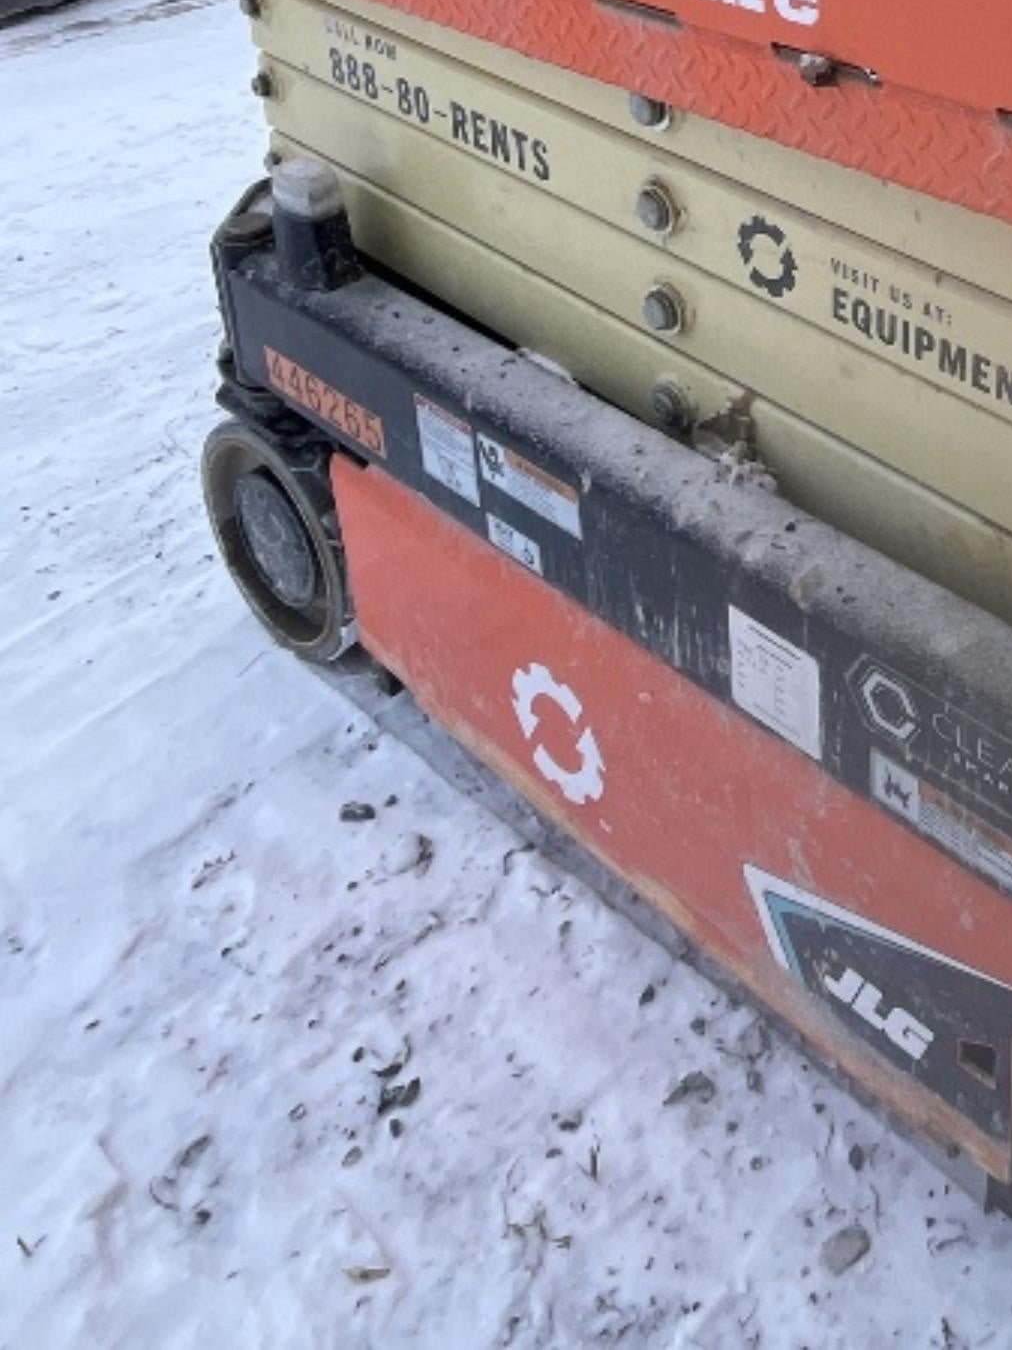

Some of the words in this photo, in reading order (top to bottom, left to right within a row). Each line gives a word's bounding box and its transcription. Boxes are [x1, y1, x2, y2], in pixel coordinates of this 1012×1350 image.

[329, 47, 550, 181] 888-80-RENTS
[830, 257, 880, 294] VISIT
[889, 284, 913, 310] US
[923, 301, 952, 327] AT:
[824, 968, 934, 1060] JLG
